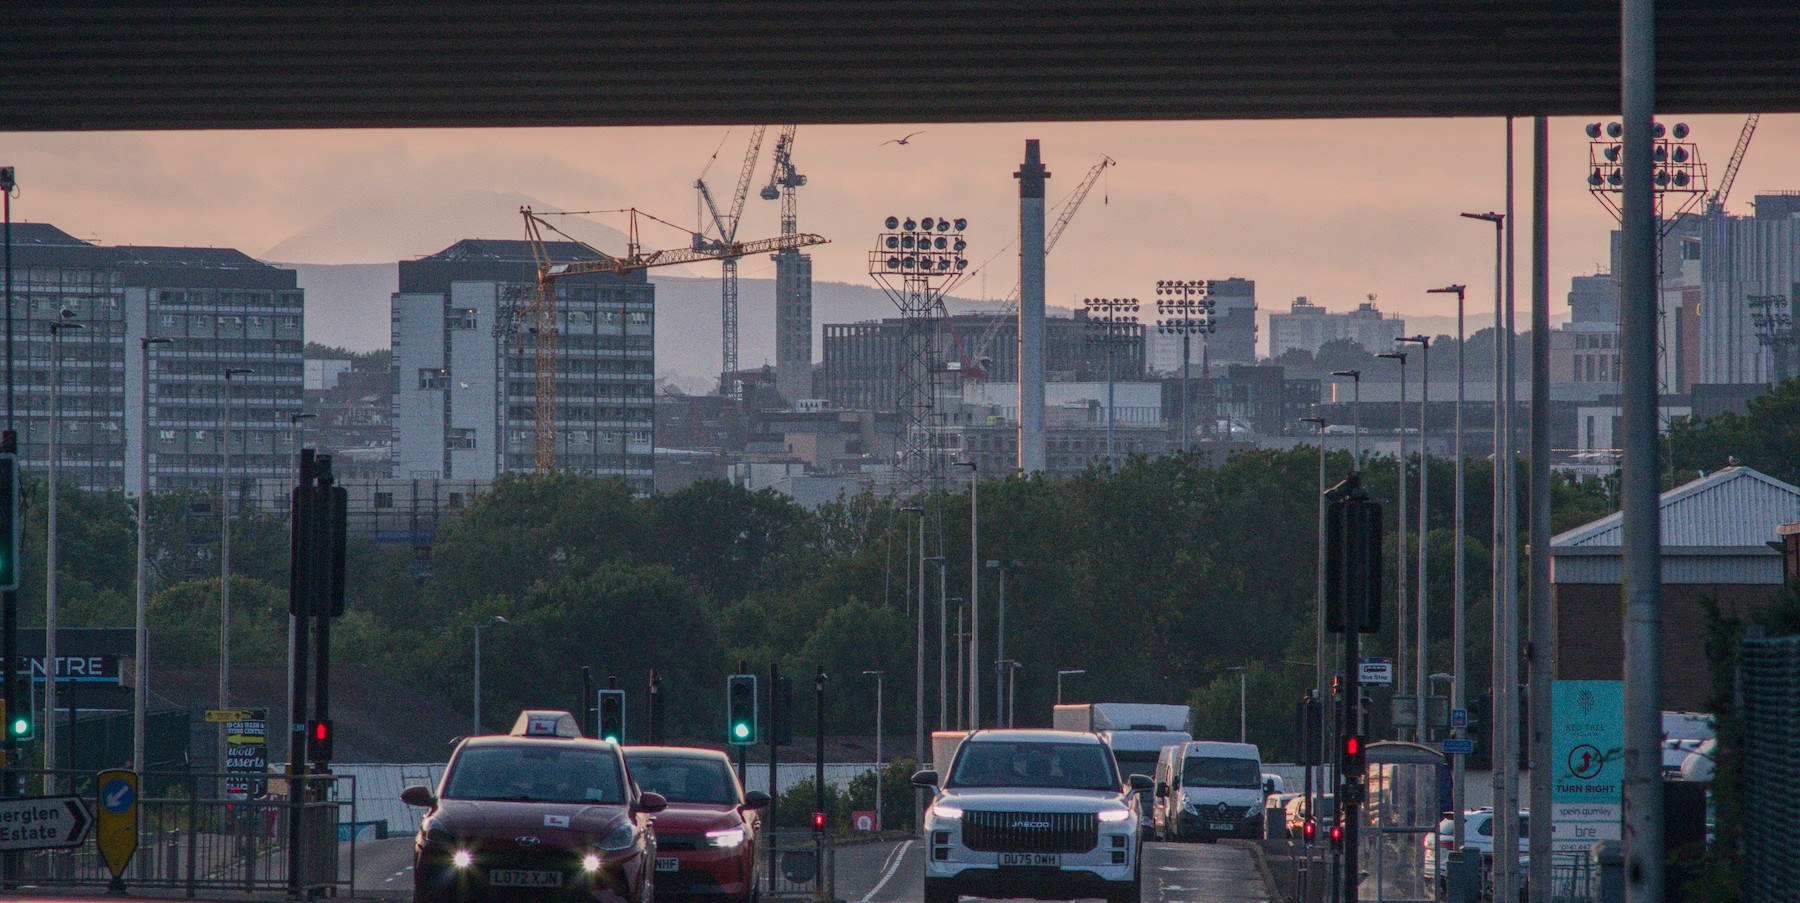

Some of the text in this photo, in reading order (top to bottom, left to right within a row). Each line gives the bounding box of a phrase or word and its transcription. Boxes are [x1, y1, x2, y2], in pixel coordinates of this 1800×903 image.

[0, 657, 103, 675] NTRE
[226, 756, 264, 768] esserts
[1556, 785, 1615, 793] TURN RIGHT
[0, 806, 59, 824] erglen
[0, 825, 56, 841] Estate
[1575, 825, 1597, 838] bre
[655, 858, 677, 869] NHF
[1004, 854, 1032, 864] DU75
